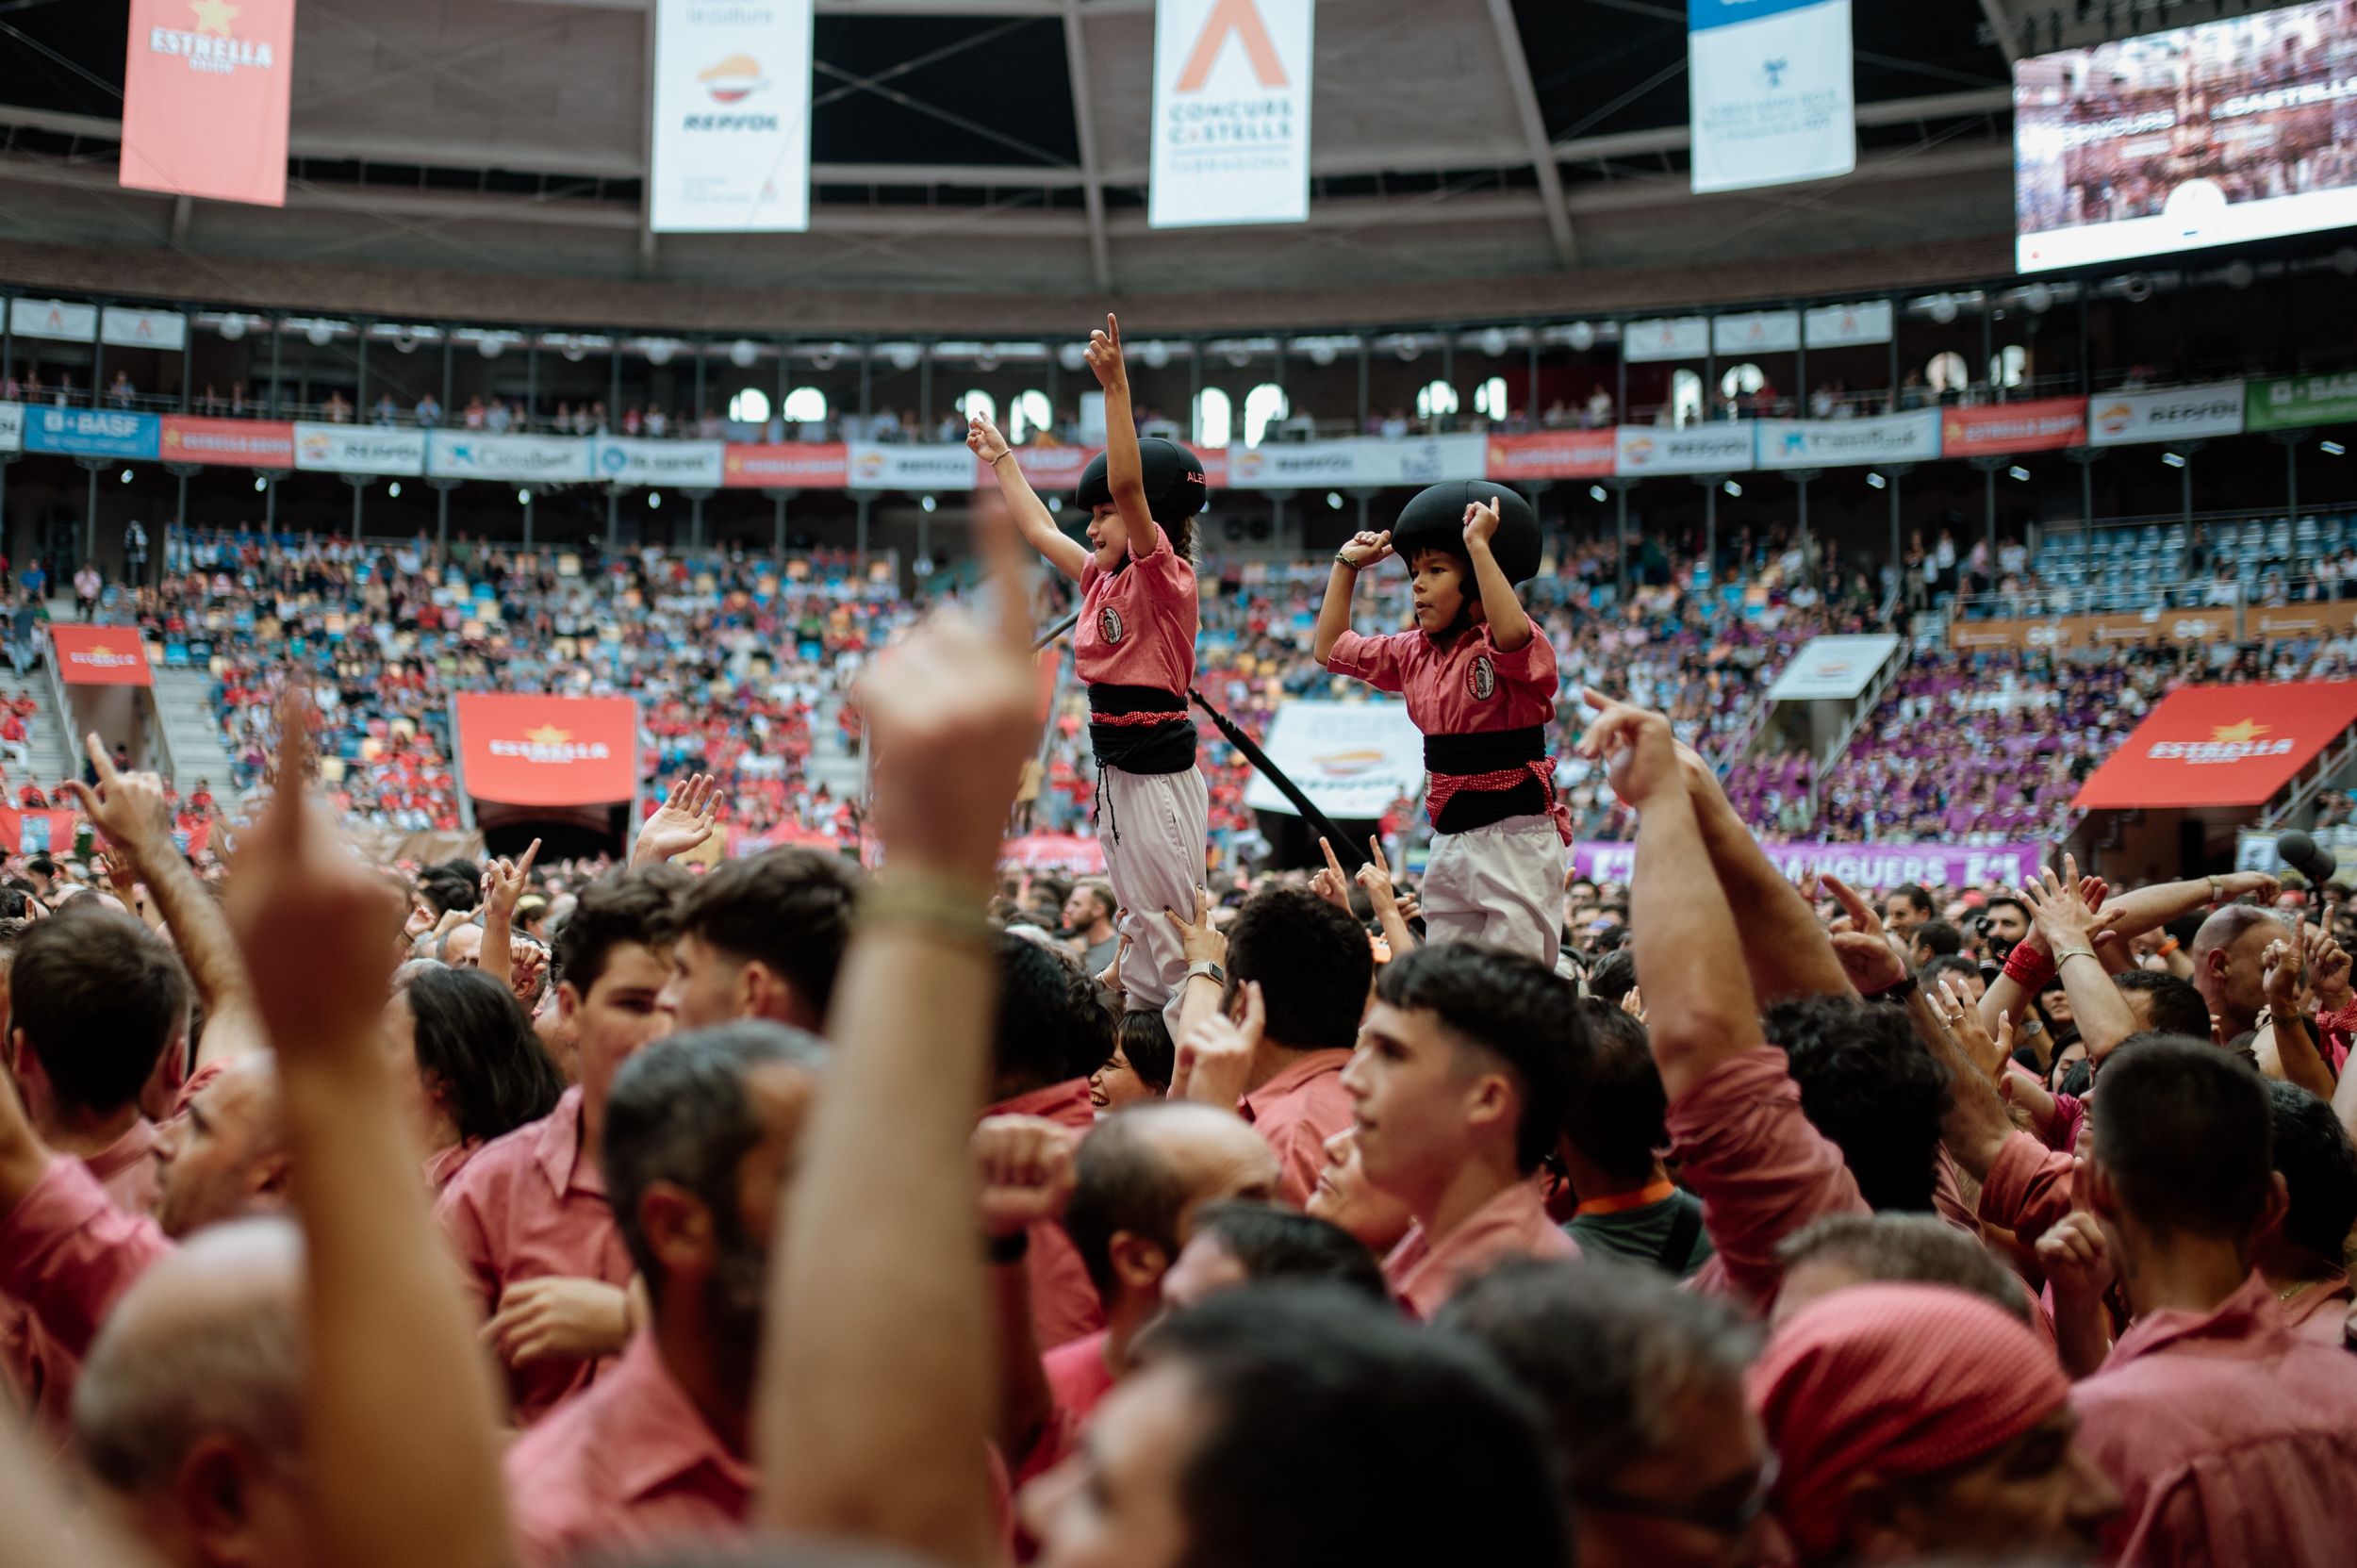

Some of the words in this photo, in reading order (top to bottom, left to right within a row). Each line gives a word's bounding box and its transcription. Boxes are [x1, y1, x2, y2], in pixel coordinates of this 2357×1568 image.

[150, 26, 272, 70] ESTRELLA
[683, 113, 779, 131] REPSOL
[1169, 99, 1292, 122] CONCURS
[2308, 372, 2357, 403] BAS
[2149, 398, 2239, 423] REPSOL
[77, 412, 139, 438] BASF
[488, 739, 611, 760] ESTRELLA
[2148, 738, 2296, 759] ESTRELLA
[1767, 854, 1948, 889] ANGUERS
